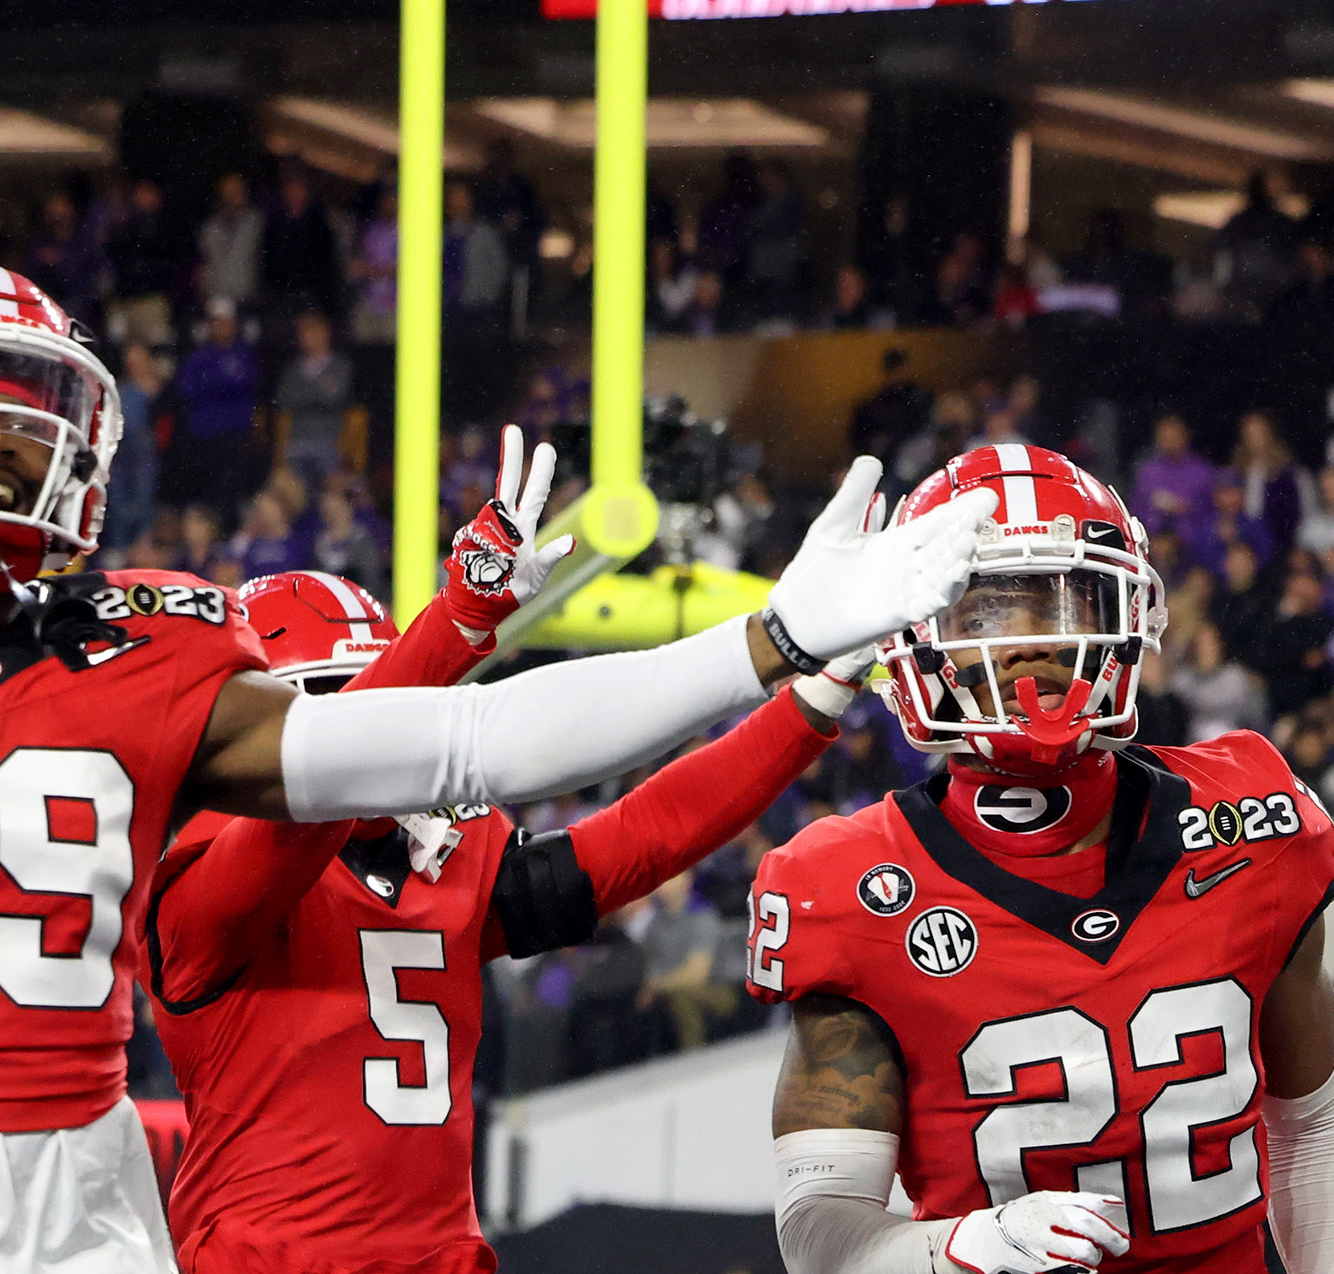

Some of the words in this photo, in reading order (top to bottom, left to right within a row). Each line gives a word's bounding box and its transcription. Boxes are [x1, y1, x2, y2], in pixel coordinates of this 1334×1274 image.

[1004, 526, 1049, 536] DAWGS
[912, 912, 971, 972] SEC
[1073, 910, 1119, 940] G
[357, 928, 452, 1126] 5
[957, 974, 1265, 1238] 22
[787, 1164, 835, 1177] DRI-FIT
